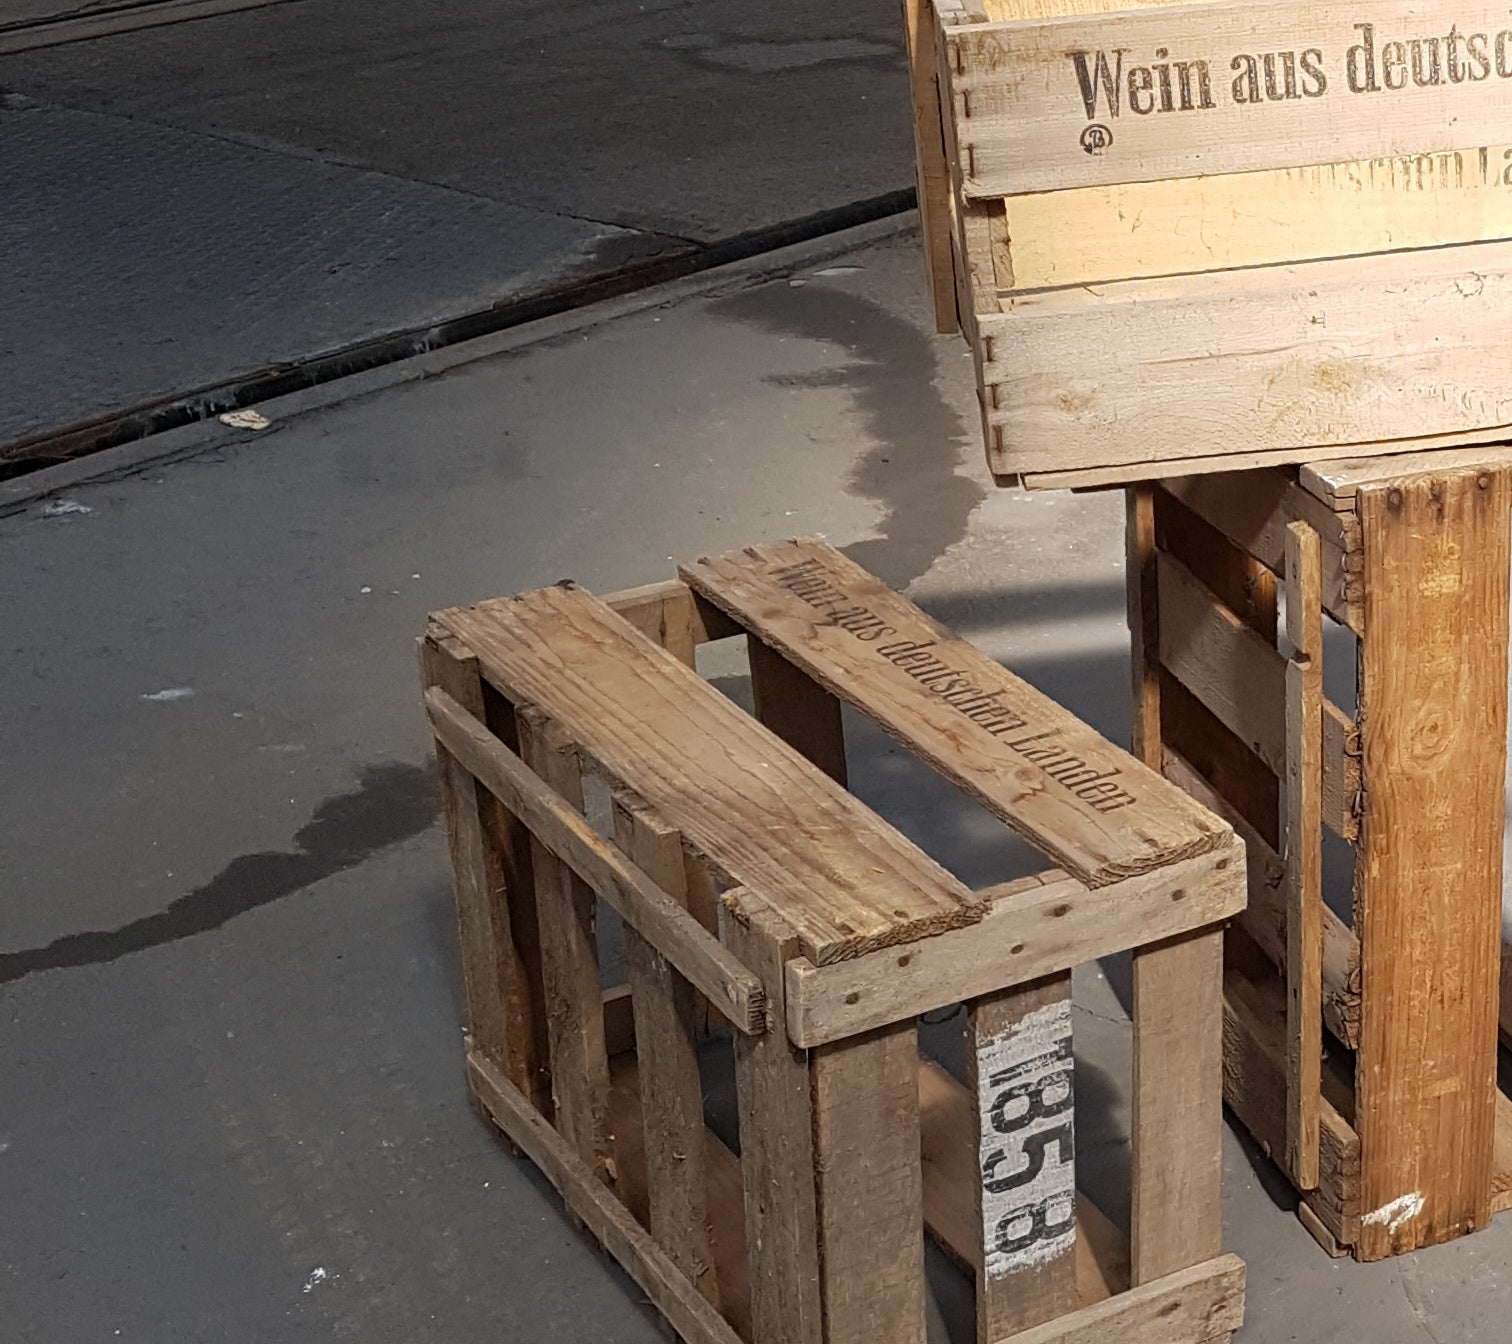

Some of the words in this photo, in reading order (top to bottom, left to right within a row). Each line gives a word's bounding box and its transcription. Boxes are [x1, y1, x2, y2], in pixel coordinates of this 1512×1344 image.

[1066, 47, 1217, 120] Wein
[1229, 47, 1329, 105] aus
[767, 557, 850, 610] Wein
[825, 604, 898, 643] aus
[875, 638, 1029, 738] deutschen
[1004, 727, 1138, 815] Landen
